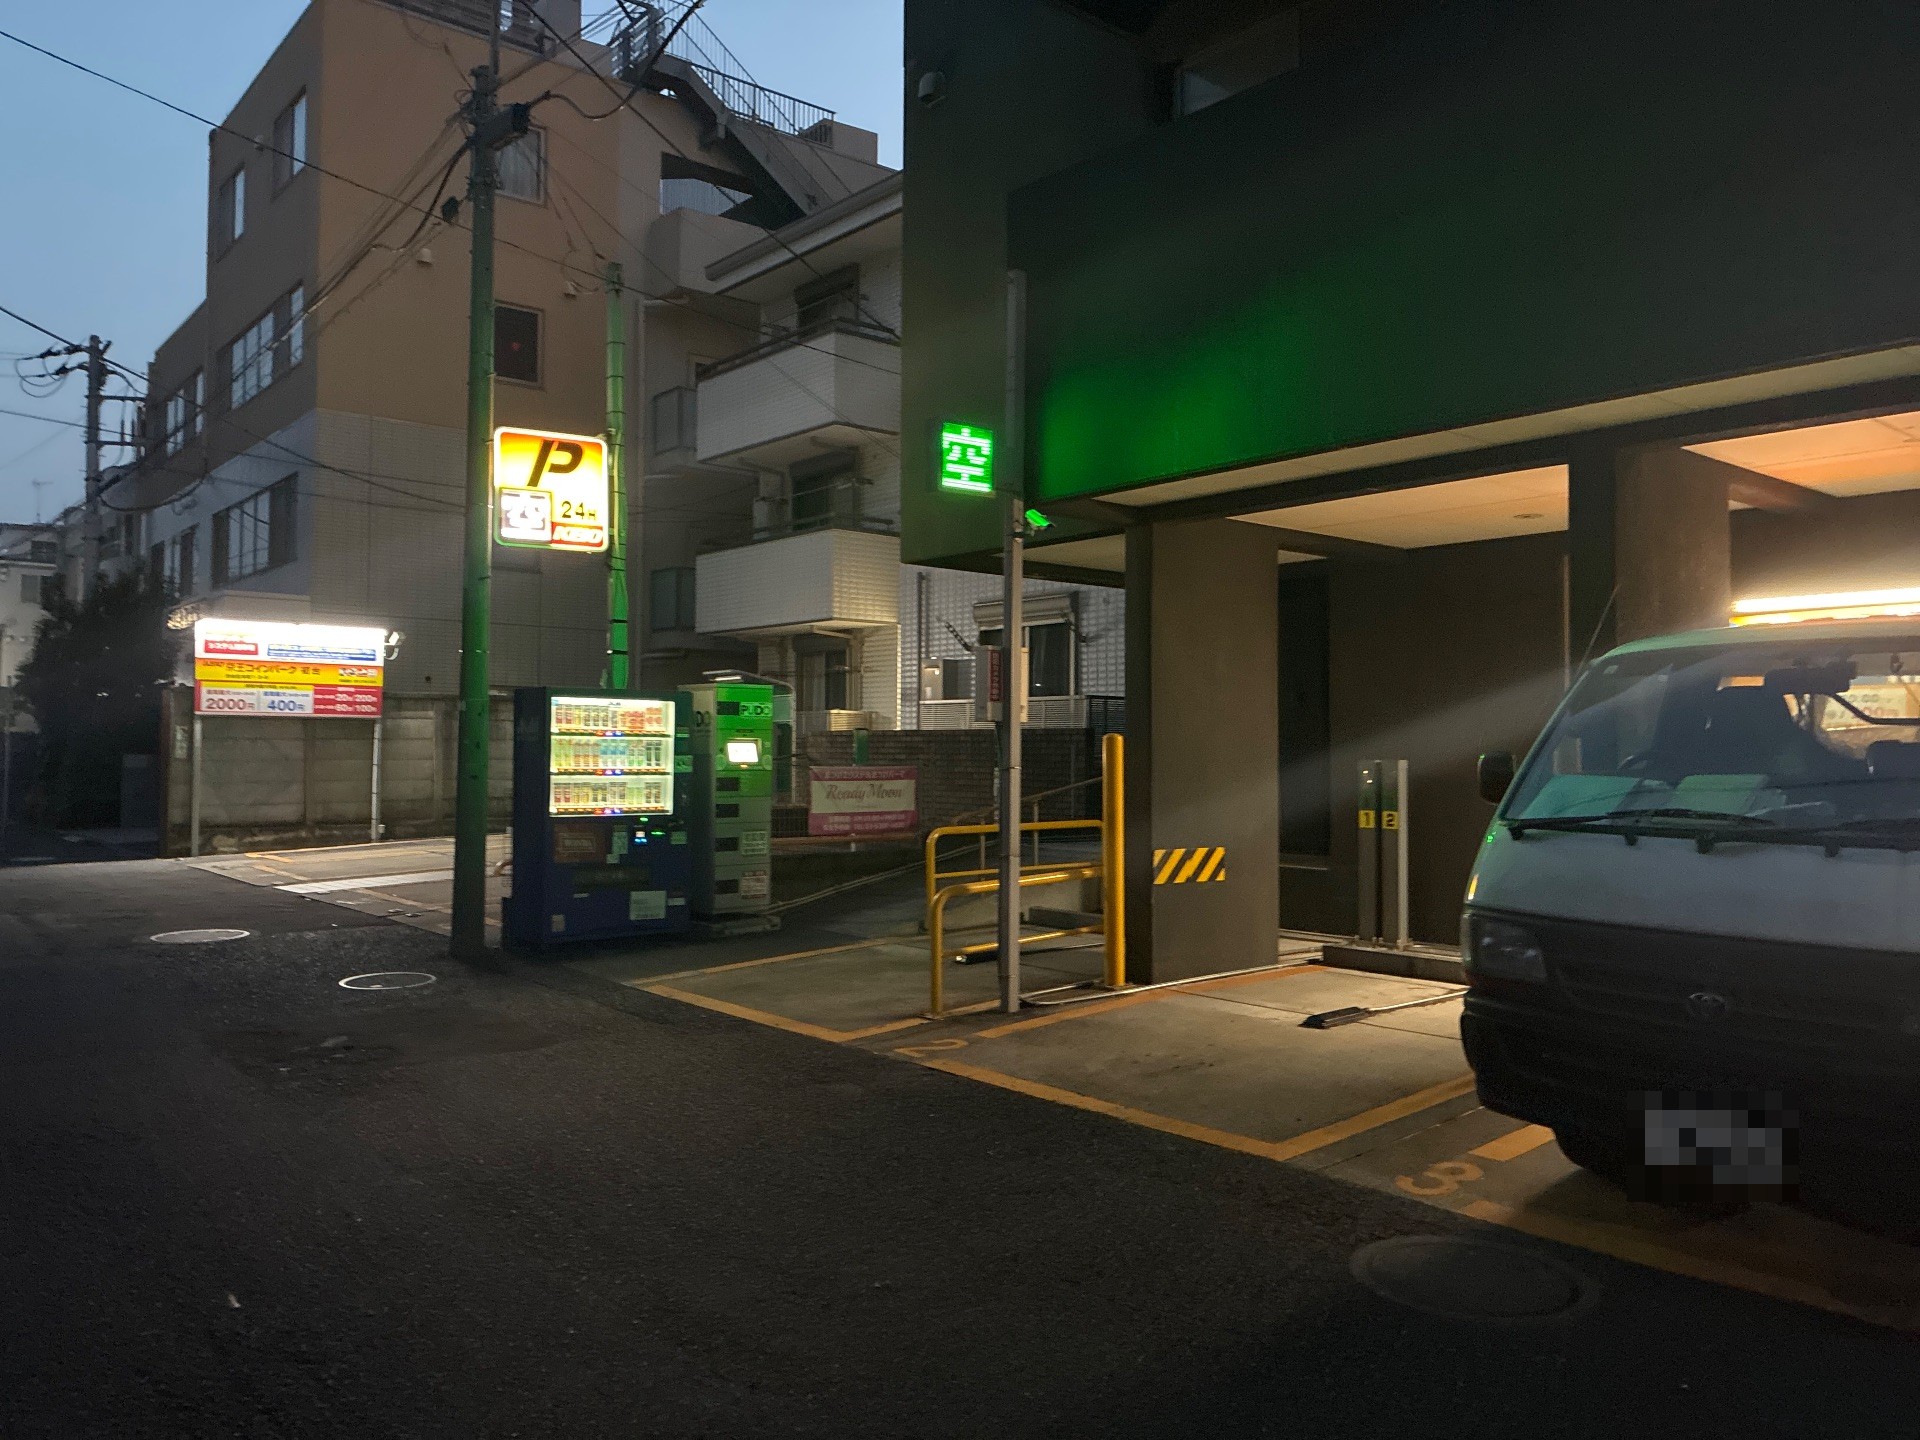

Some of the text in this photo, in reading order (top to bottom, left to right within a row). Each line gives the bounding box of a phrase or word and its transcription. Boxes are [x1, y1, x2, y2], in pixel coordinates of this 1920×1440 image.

[527, 440, 583, 487] P
[942, 428, 992, 492] 空
[206, 698, 256, 710] 2000円
[267, 700, 305, 711] 400円
